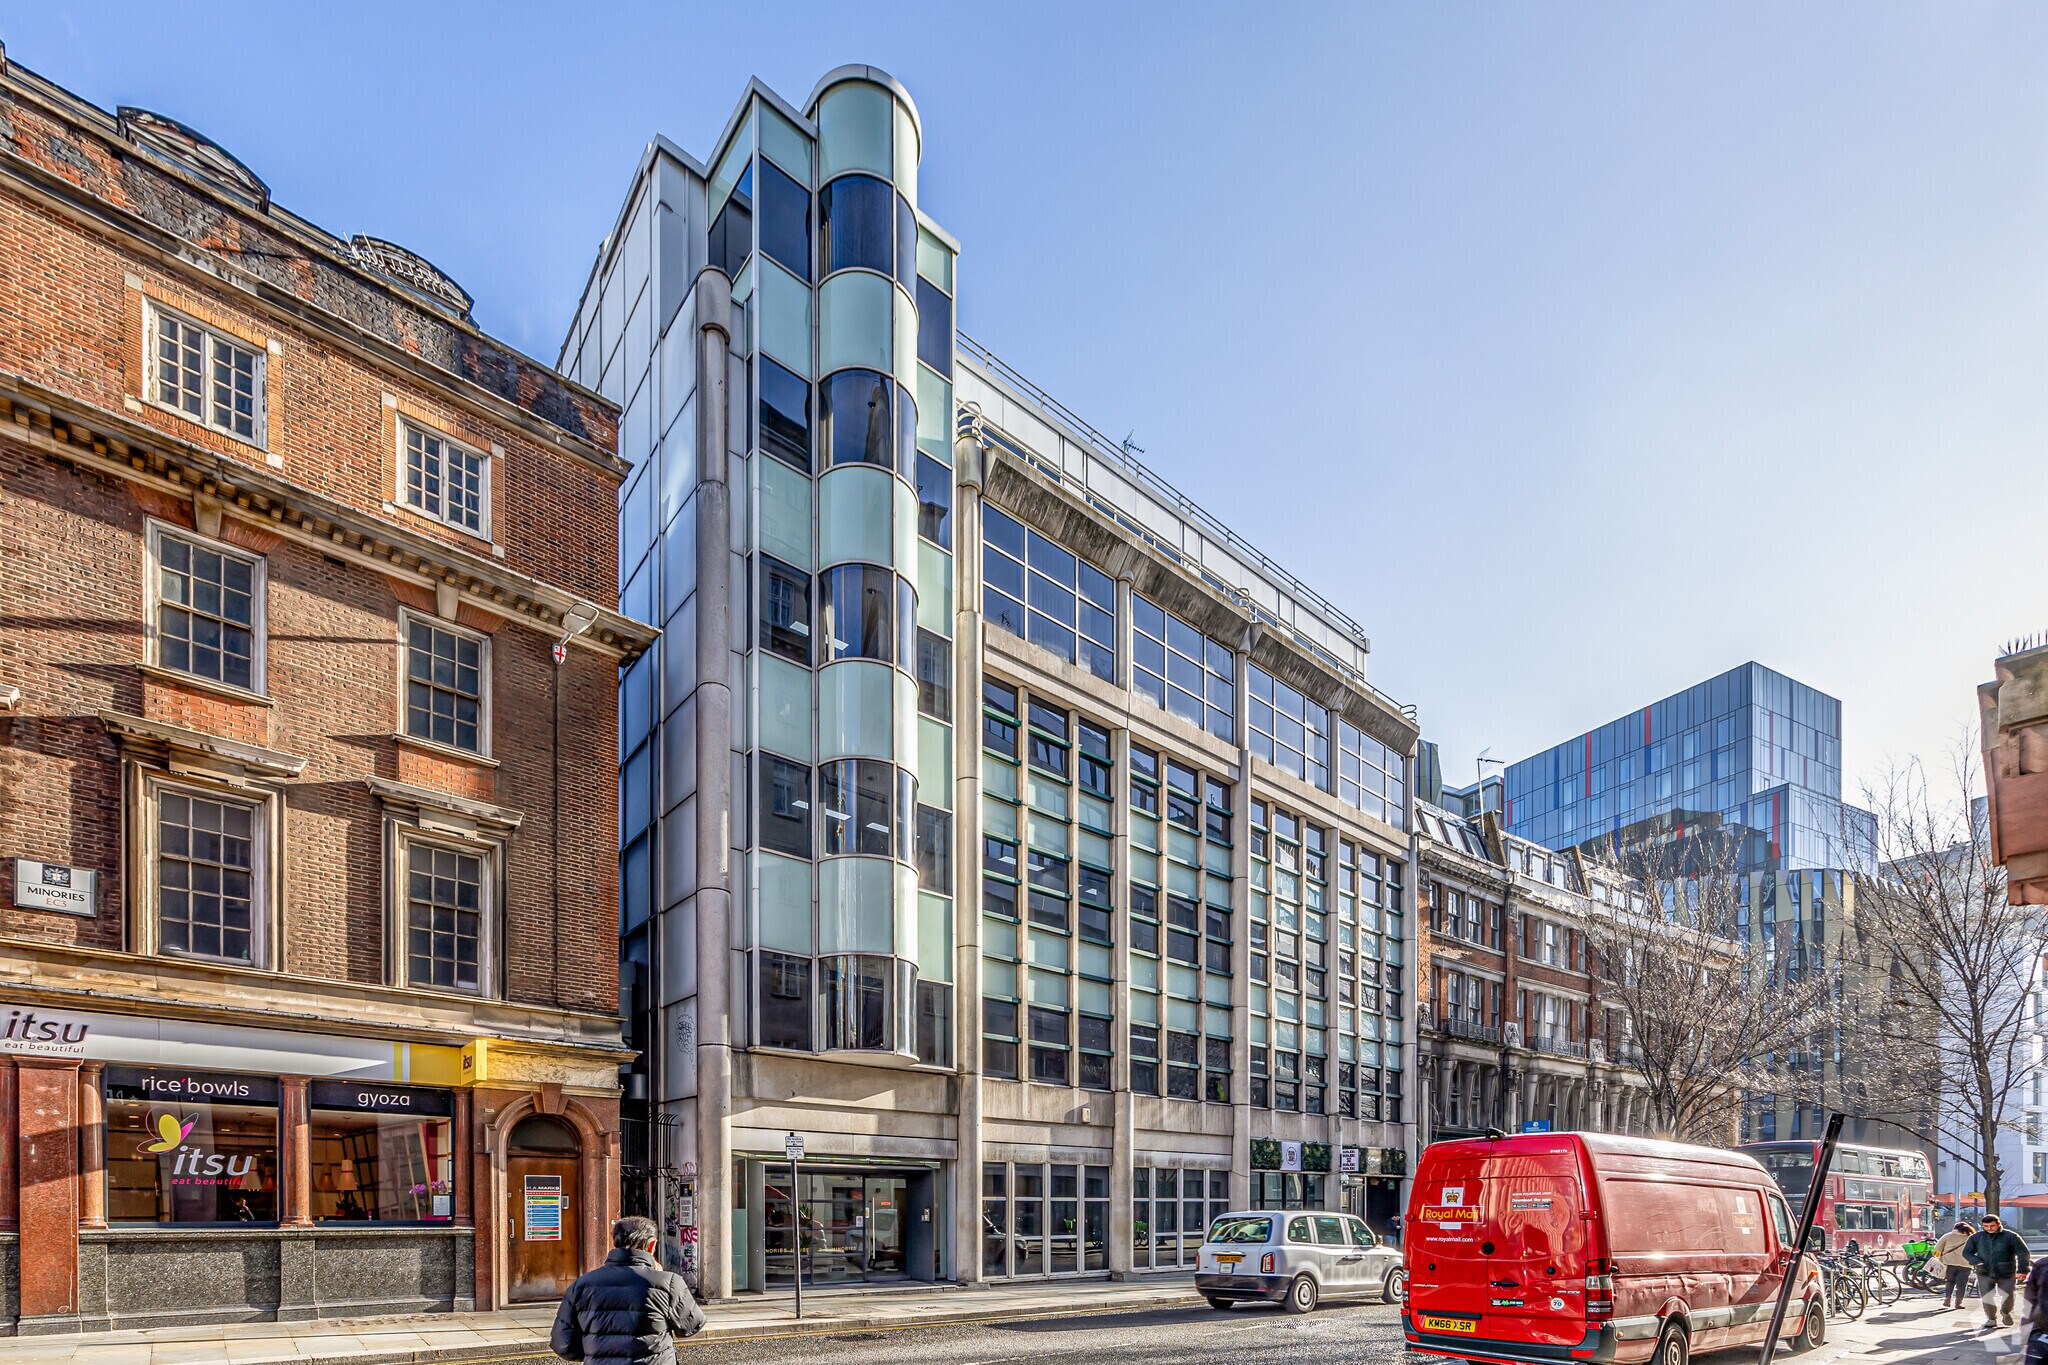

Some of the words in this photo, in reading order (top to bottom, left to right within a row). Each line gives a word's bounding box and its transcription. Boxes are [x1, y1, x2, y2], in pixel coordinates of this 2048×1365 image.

[27, 886, 85, 902] MINORIES
[46, 898, 67, 908] EC3
[6, 1011, 88, 1043] itsu
[29, 1043, 84, 1053] beautiful
[141, 1076, 182, 1092] rice
[187, 1078, 249, 1096] bowls
[358, 1092, 410, 1107] gyoza
[173, 1145, 253, 1176] itsu
[1425, 1209, 1453, 1220] Royal
[1428, 1318, 1451, 1329] KM66
